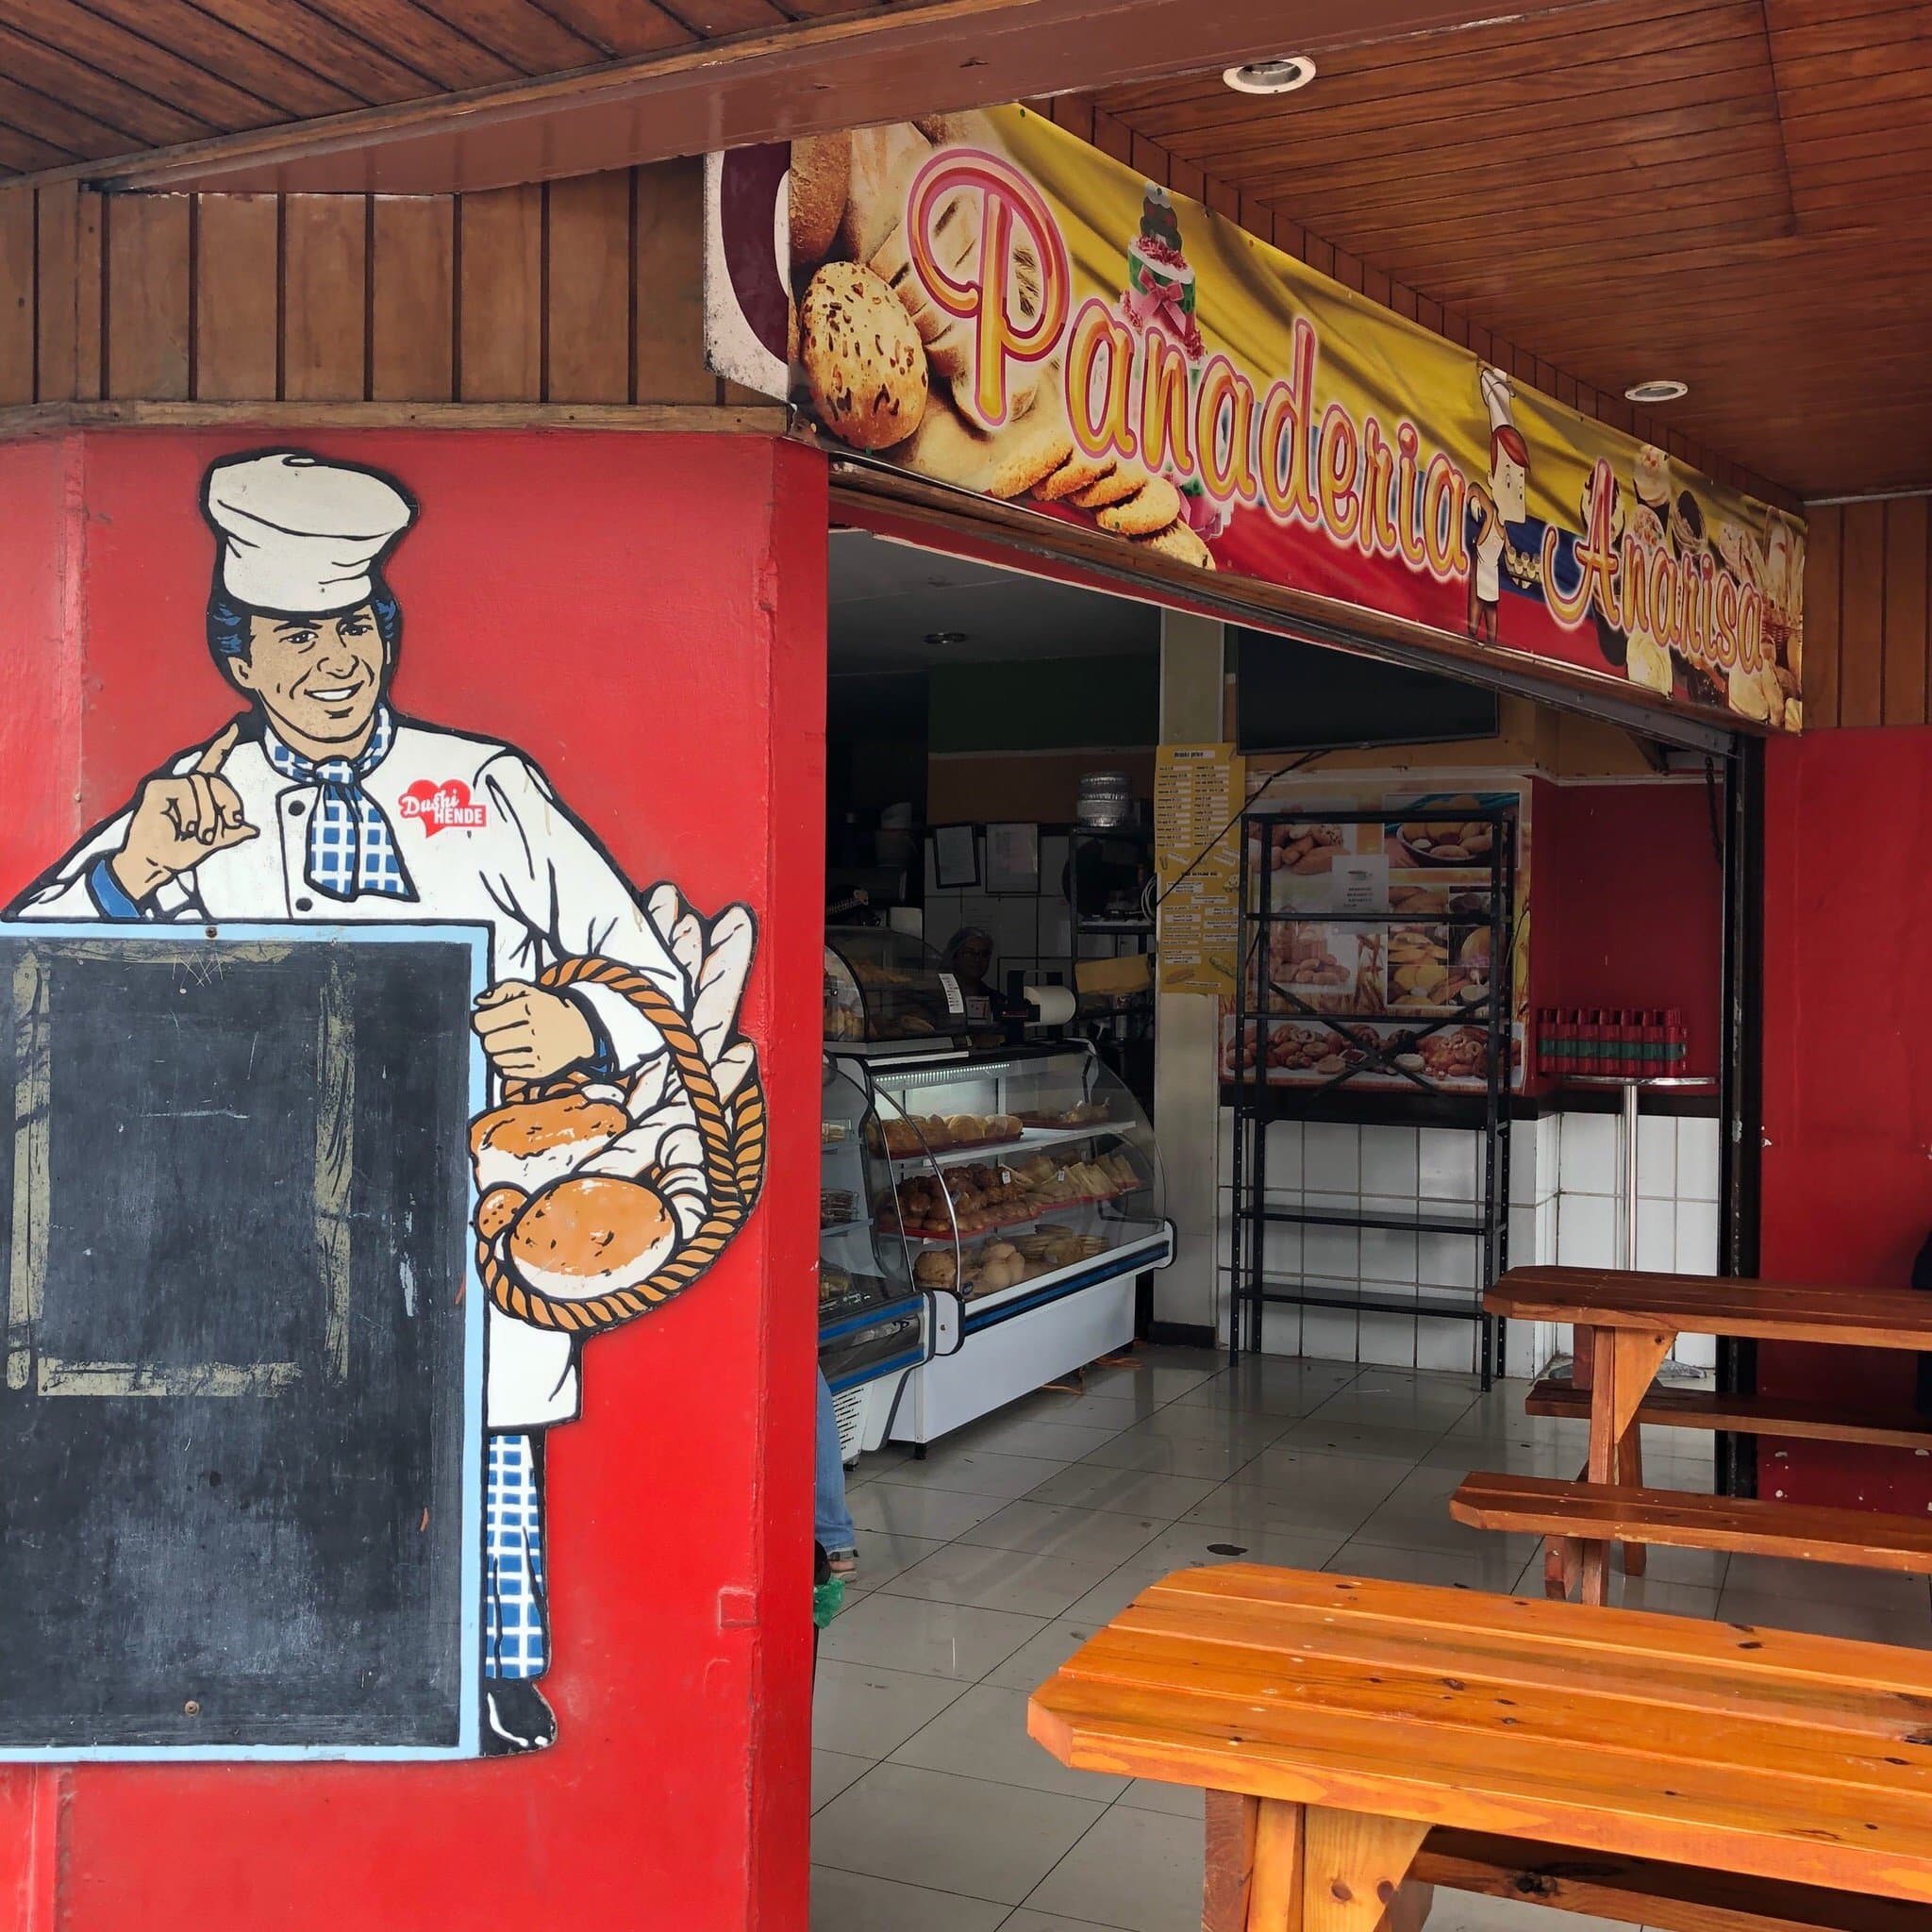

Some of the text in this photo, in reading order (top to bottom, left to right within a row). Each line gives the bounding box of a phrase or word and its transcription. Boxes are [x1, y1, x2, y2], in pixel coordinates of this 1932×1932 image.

[907, 147, 1764, 675] Panaderia Anarisa
[401, 789, 459, 816] Dushi
[434, 808, 483, 824] HENDE
